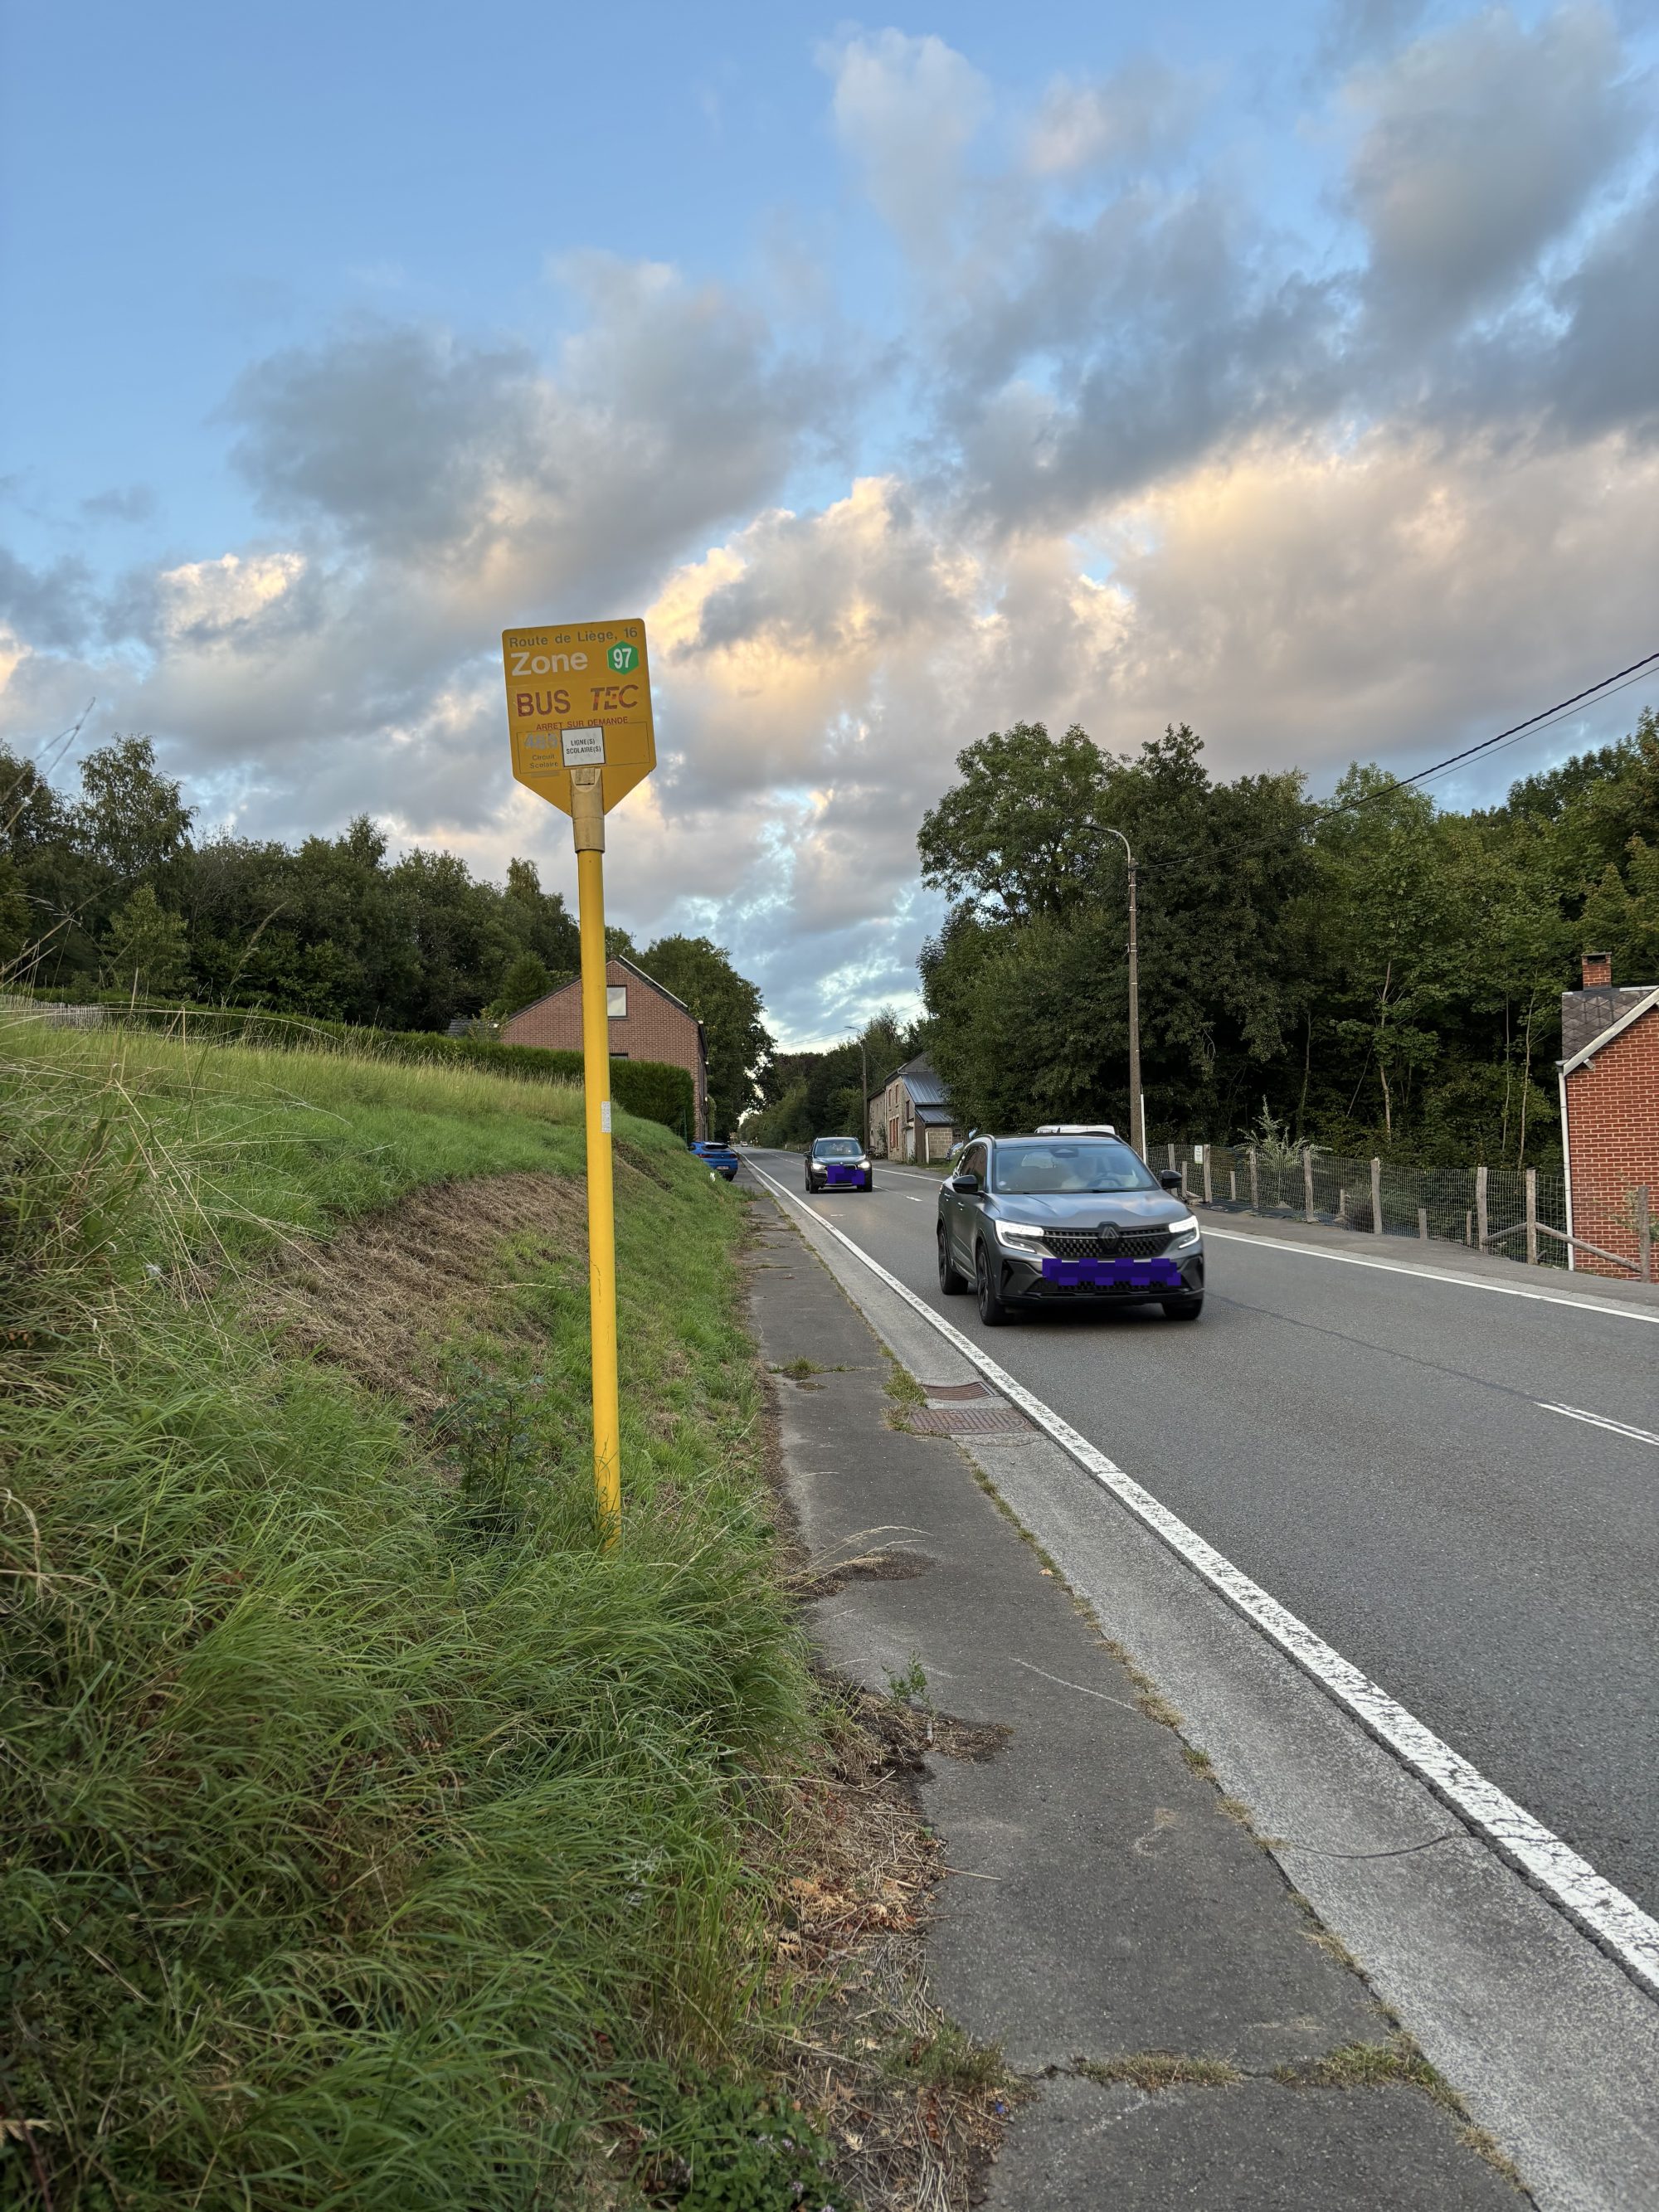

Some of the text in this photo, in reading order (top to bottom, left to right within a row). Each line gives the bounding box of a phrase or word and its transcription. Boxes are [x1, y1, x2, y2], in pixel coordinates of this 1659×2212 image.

[509, 627, 638, 648] Route de Liège, 16
[511, 648, 631, 676] Zone 97
[517, 684, 639, 717] BUS TEC
[537, 717, 628, 731] ARRET SUR DEMANDE
[566, 746, 601, 755] SCOLAIRE(S)
